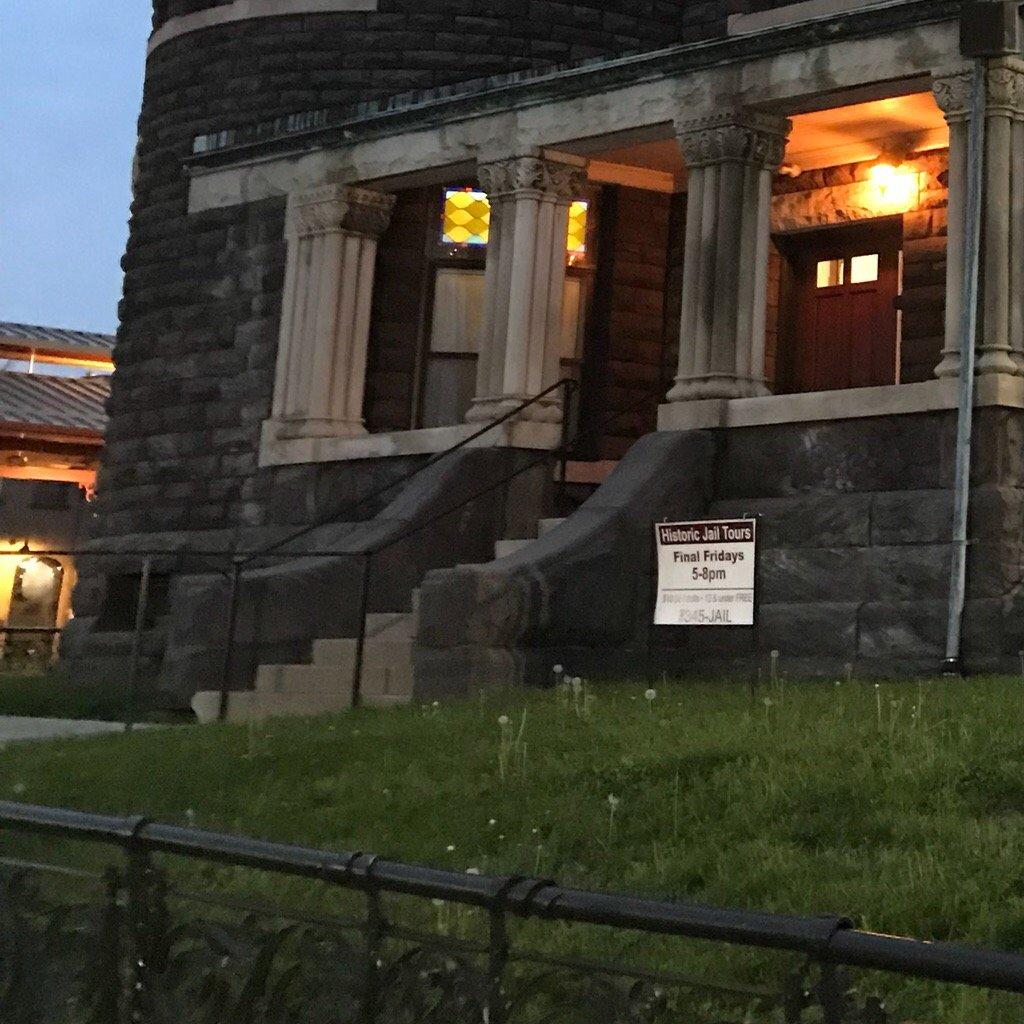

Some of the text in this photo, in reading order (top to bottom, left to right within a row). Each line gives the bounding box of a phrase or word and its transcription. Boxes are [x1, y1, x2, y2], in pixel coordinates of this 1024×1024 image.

[661, 526, 751, 542] Historic Jail Tours
[673, 550, 744, 564] Final Fridays
[692, 567, 726, 582] 5-8pm
